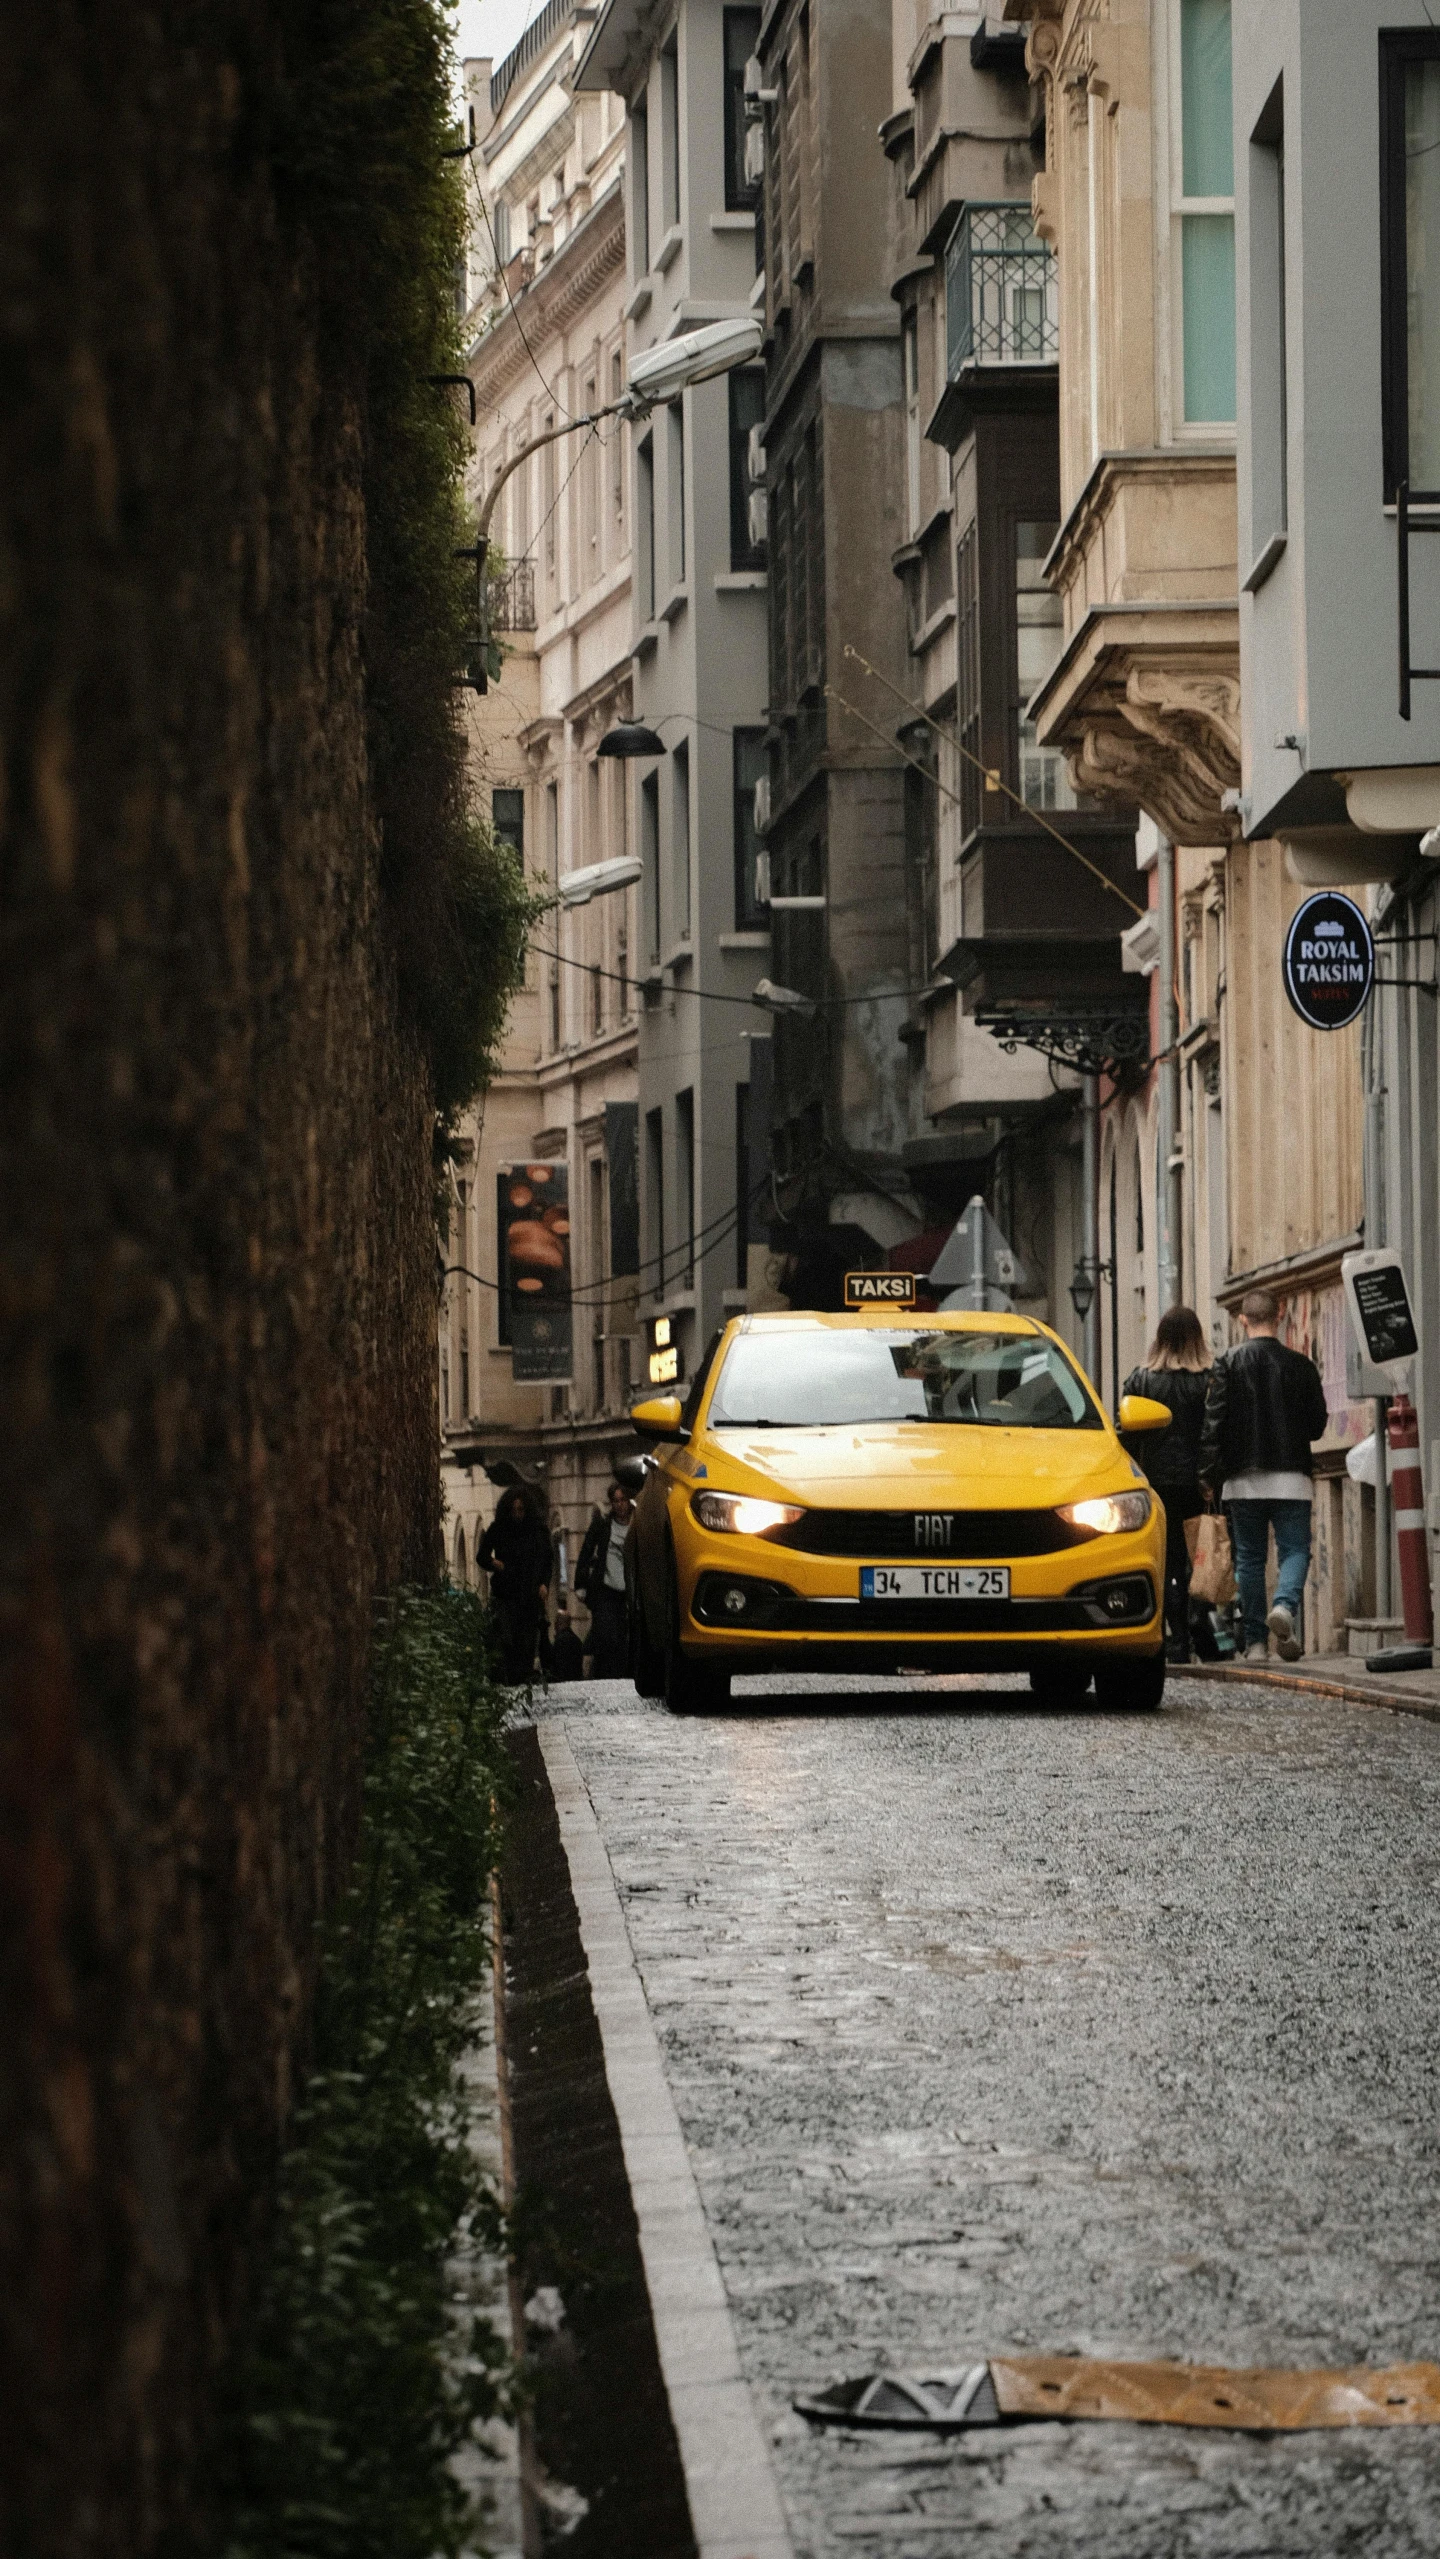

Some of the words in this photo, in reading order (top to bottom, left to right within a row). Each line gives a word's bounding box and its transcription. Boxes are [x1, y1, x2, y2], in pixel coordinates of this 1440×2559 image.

[1301, 941, 1360, 959] ROYAL
[1296, 960, 1364, 982] TAKSİM
[914, 1515, 954, 1546] FIAT
[876, 1571, 901, 1595] 34
[921, 1571, 960, 1595] TCH
[978, 1571, 1003, 1595] 25
